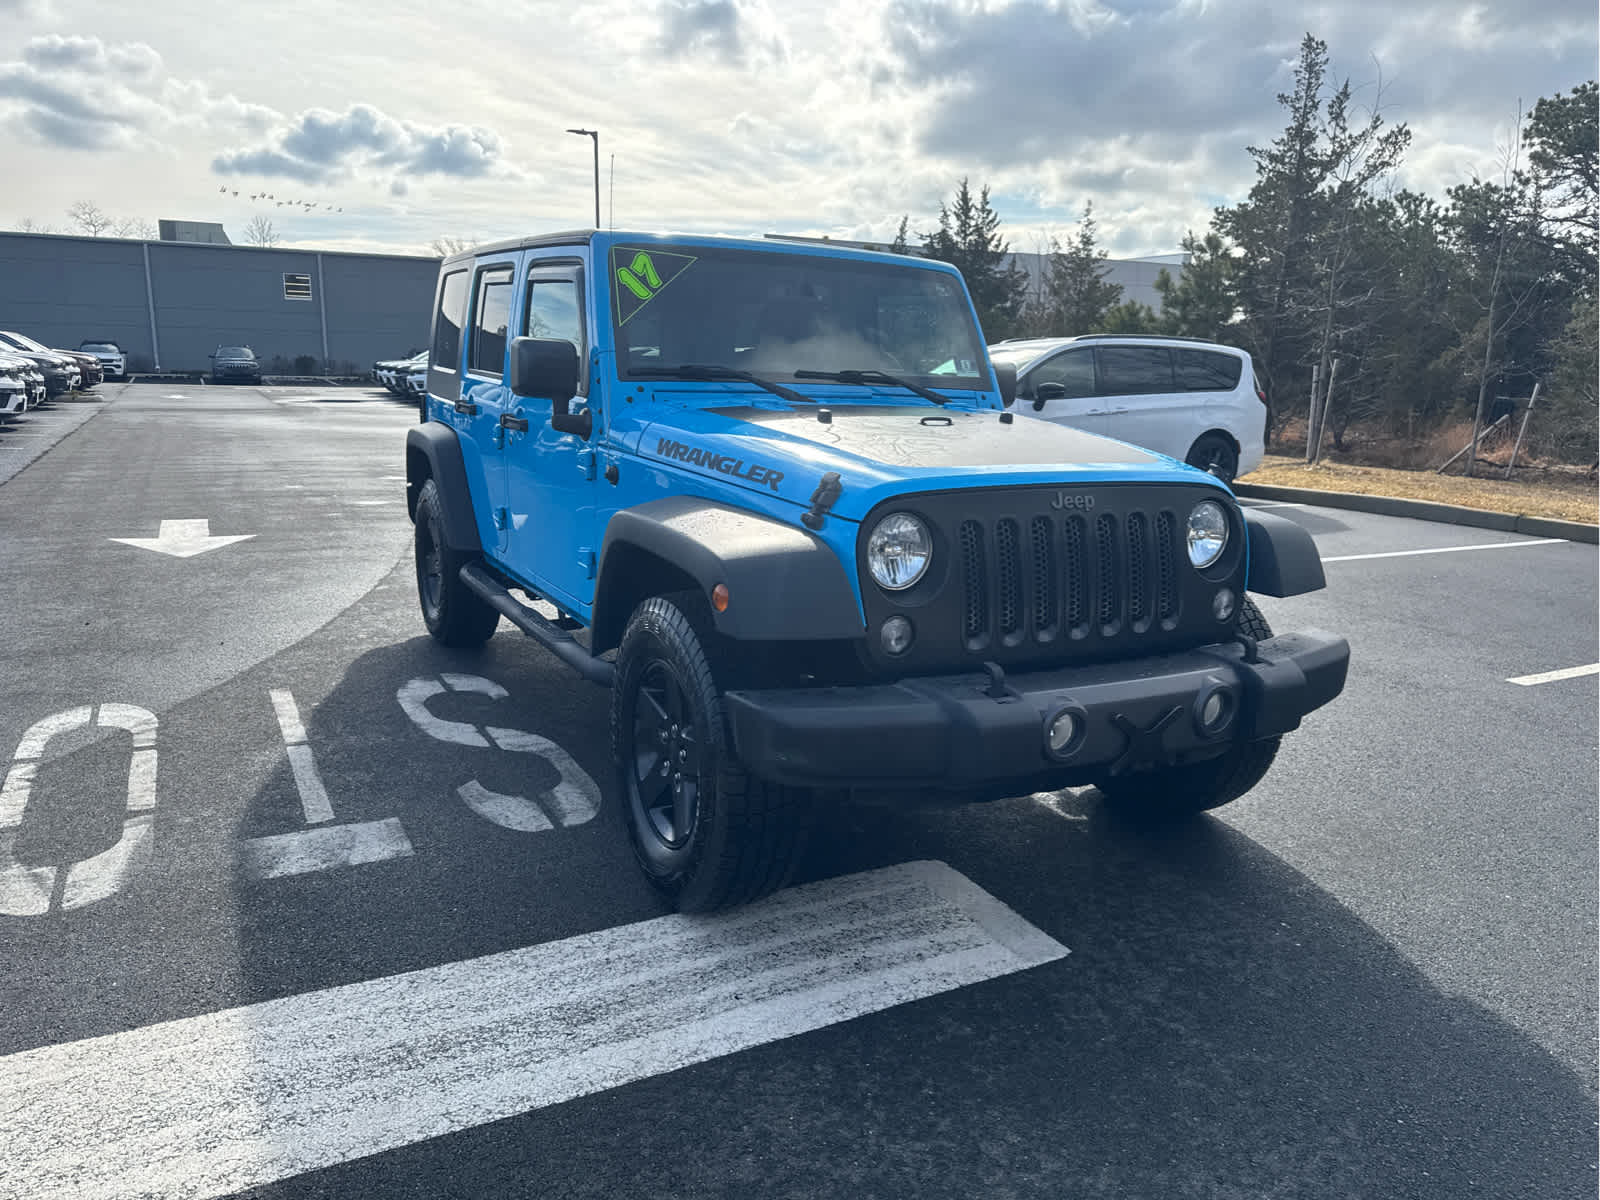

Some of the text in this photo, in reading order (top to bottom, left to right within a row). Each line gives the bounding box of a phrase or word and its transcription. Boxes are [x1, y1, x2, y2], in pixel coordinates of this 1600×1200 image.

[617, 252, 663, 300] 17
[656, 438, 785, 492] WRANGLER
[1050, 491, 1095, 512] Jeep
